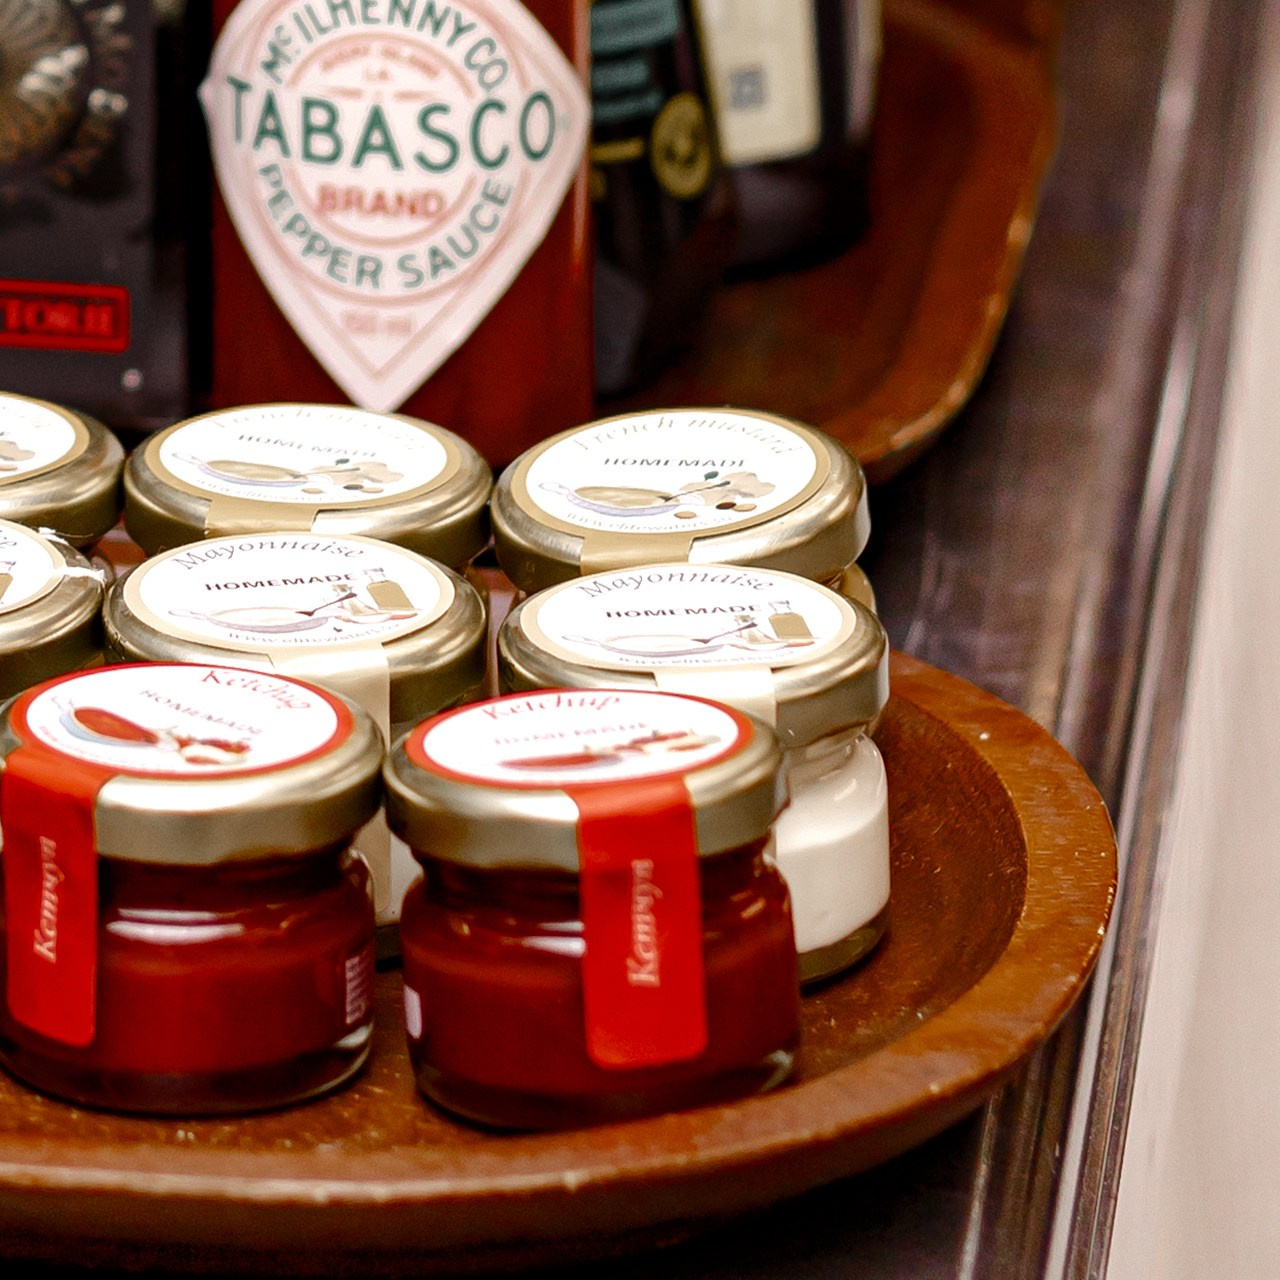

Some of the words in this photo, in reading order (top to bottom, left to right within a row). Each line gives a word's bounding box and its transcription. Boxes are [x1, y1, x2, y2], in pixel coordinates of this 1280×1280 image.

[225, 74, 557, 173] TABASCO
[317, 184, 446, 219] BRAND
[258, 163, 382, 289] PEPPER
[397, 179, 513, 289] SAUCE
[602, 456, 746, 468] HOMEMADE
[170, 539, 365, 571] Mayonnaise
[203, 572, 359, 592] HOMEMADE
[576, 571, 775, 598] Mayonnaise
[604, 604, 763, 619] HOMEMADE
[200, 669, 311, 710] Ketchup
[481, 694, 621, 720] Ketchup
[32, 835, 65, 964] Кетчуп
[626, 858, 663, 988] Кетчуп
